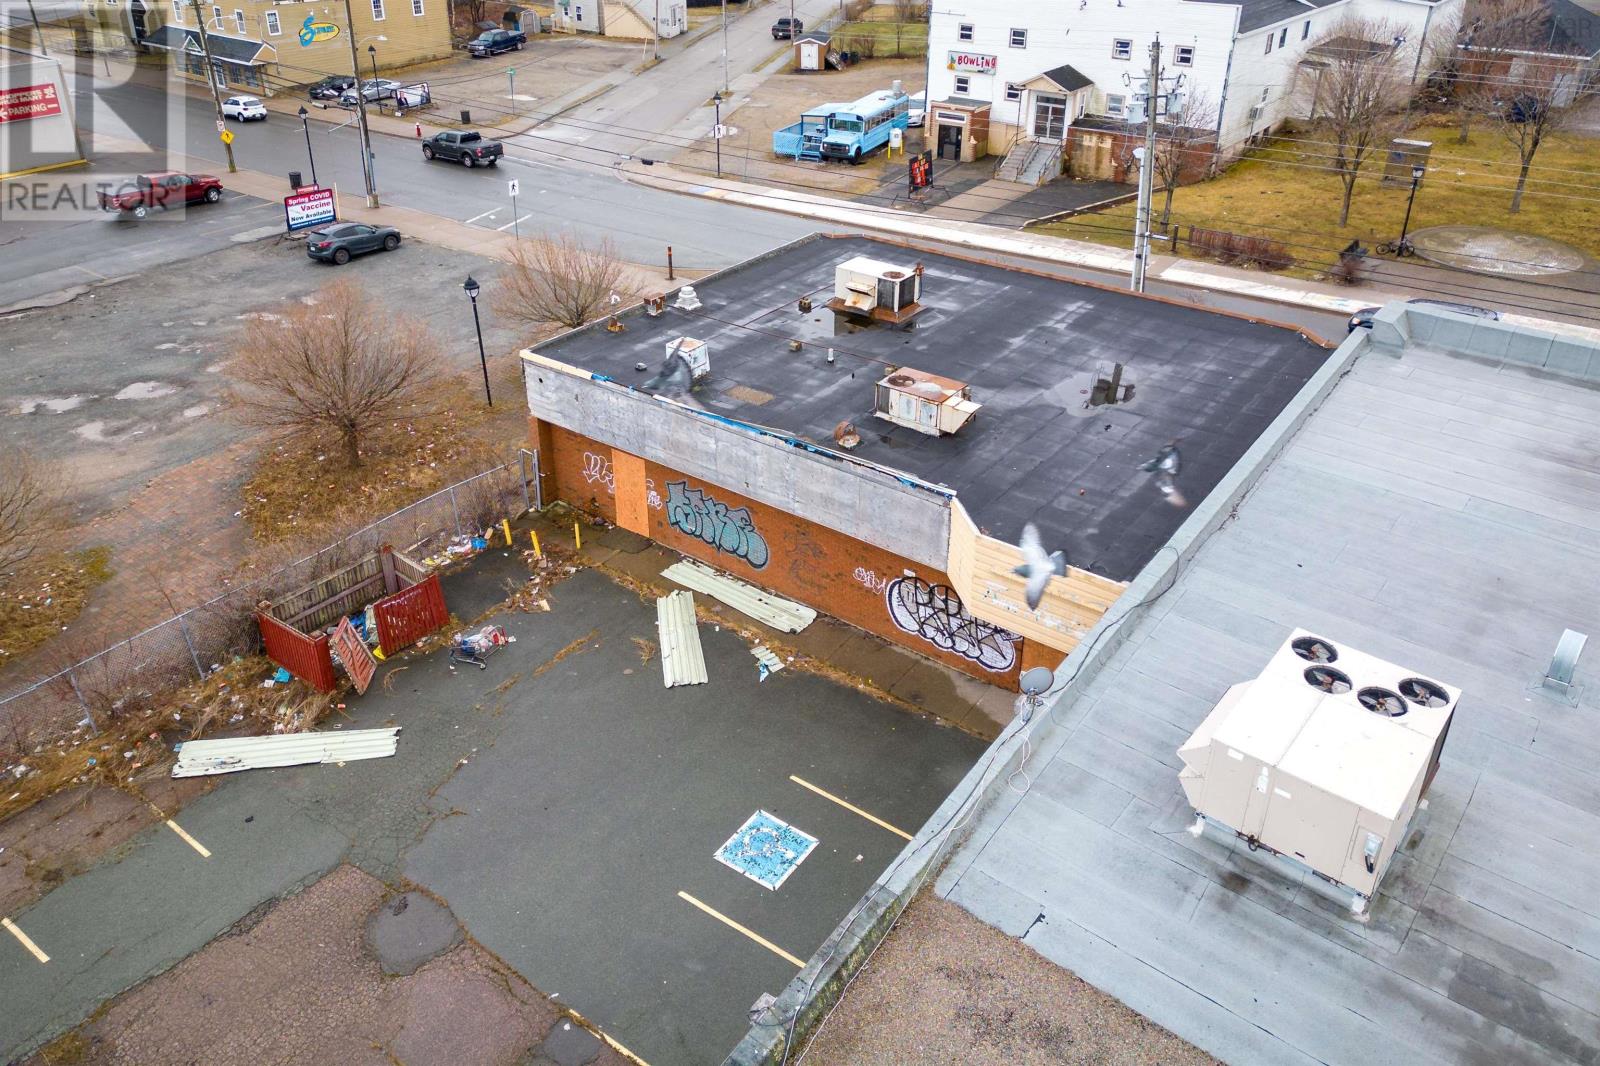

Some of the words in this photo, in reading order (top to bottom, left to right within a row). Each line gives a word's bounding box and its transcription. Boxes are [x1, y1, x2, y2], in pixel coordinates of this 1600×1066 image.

[8, 103, 47, 115] PARKING
[288, 197, 309, 206] Spring
[310, 192, 330, 201] COVID
[301, 201, 331, 212] Vaccine
[305, 209, 332, 219] Available
